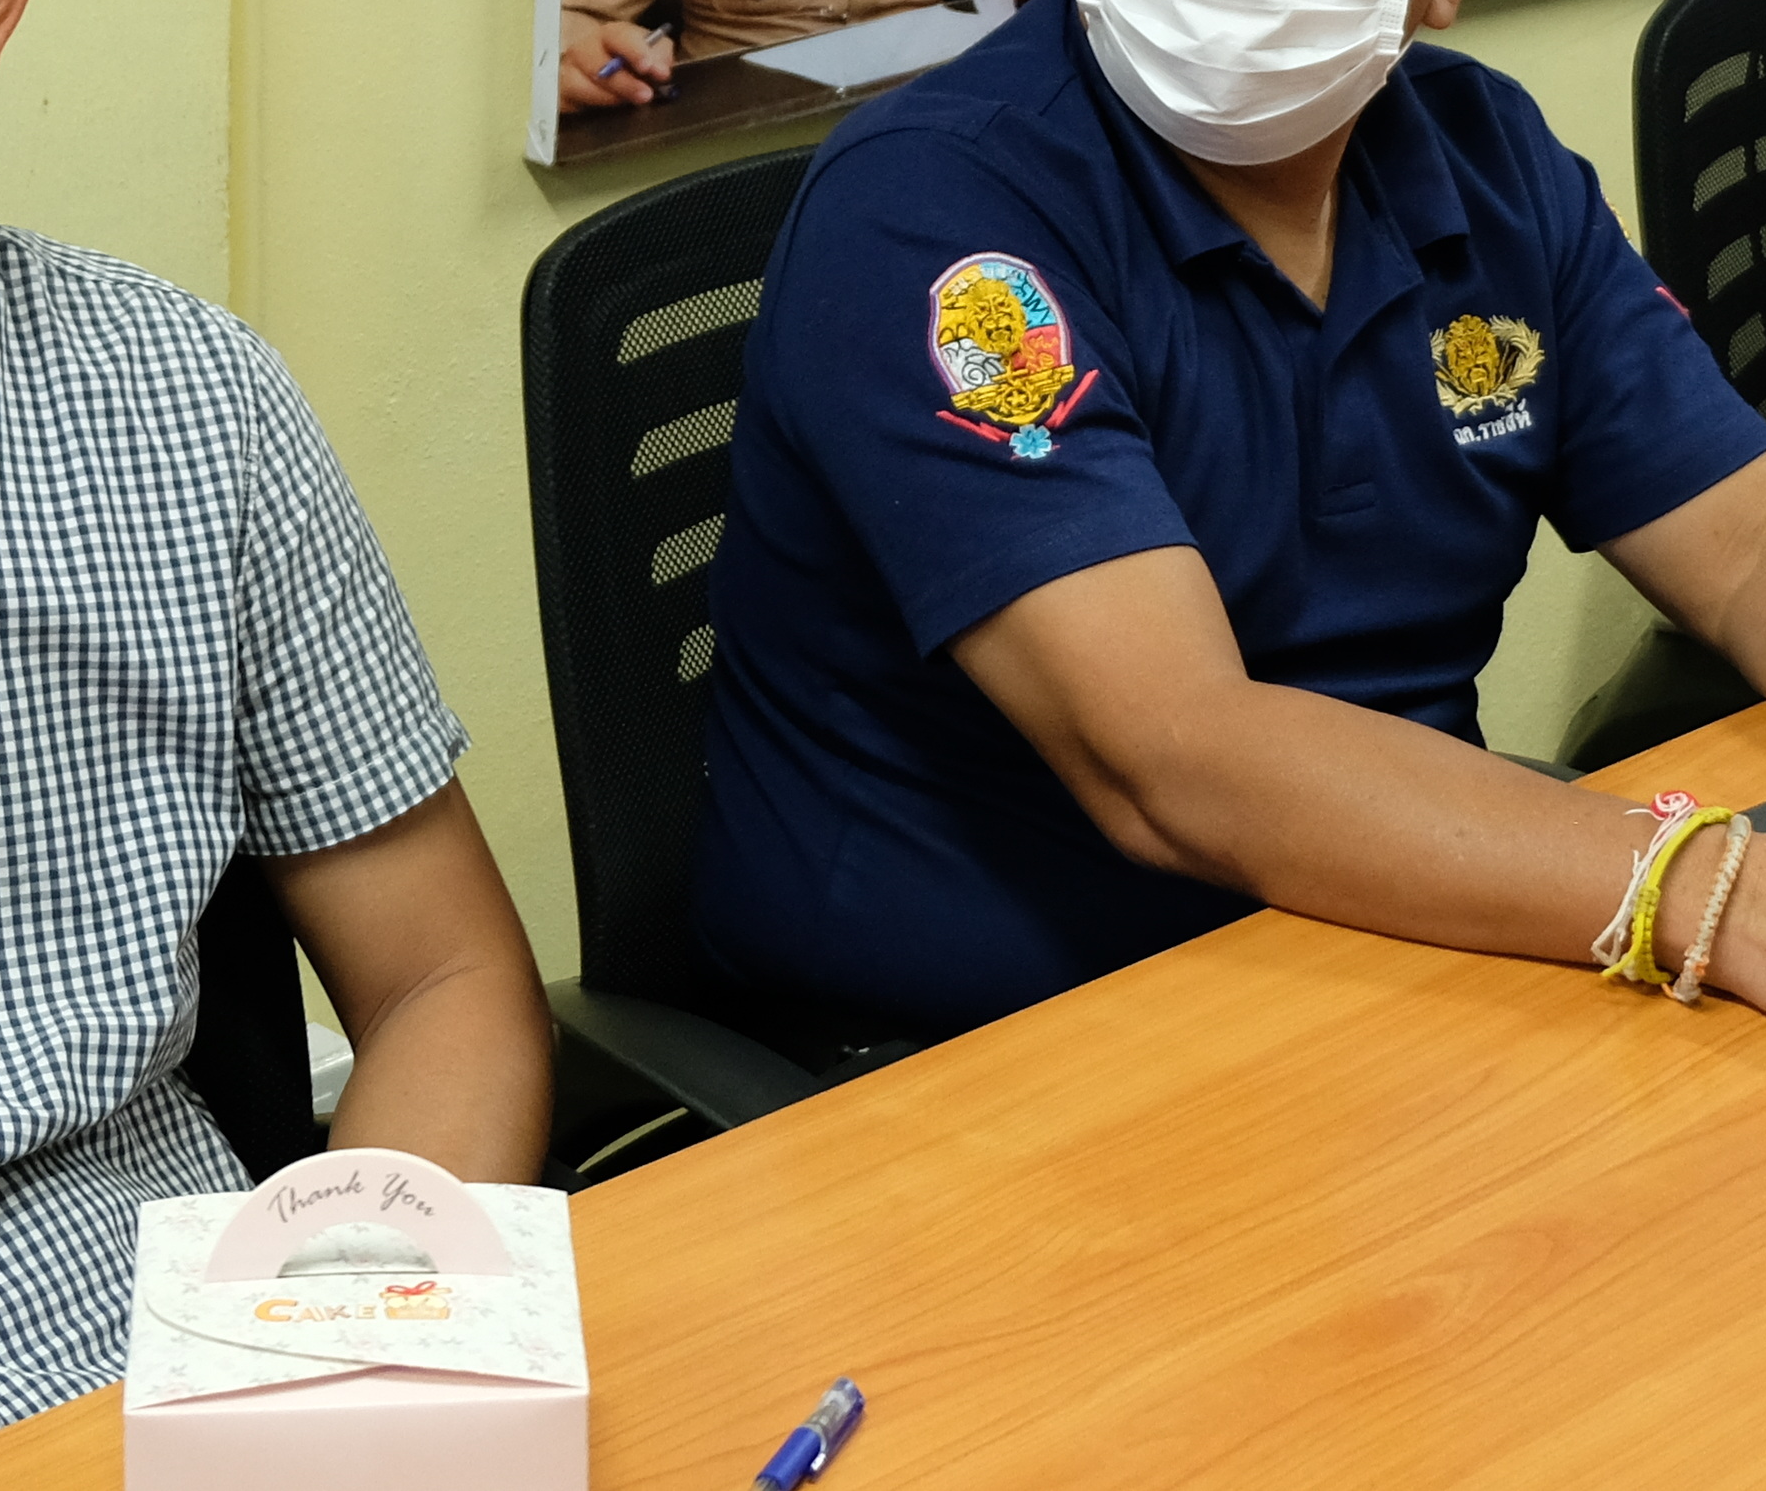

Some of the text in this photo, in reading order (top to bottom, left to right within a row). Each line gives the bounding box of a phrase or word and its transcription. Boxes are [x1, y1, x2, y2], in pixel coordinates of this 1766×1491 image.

[268, 1169, 436, 1223] Thank You
[254, 1299, 376, 1322] CAKE
